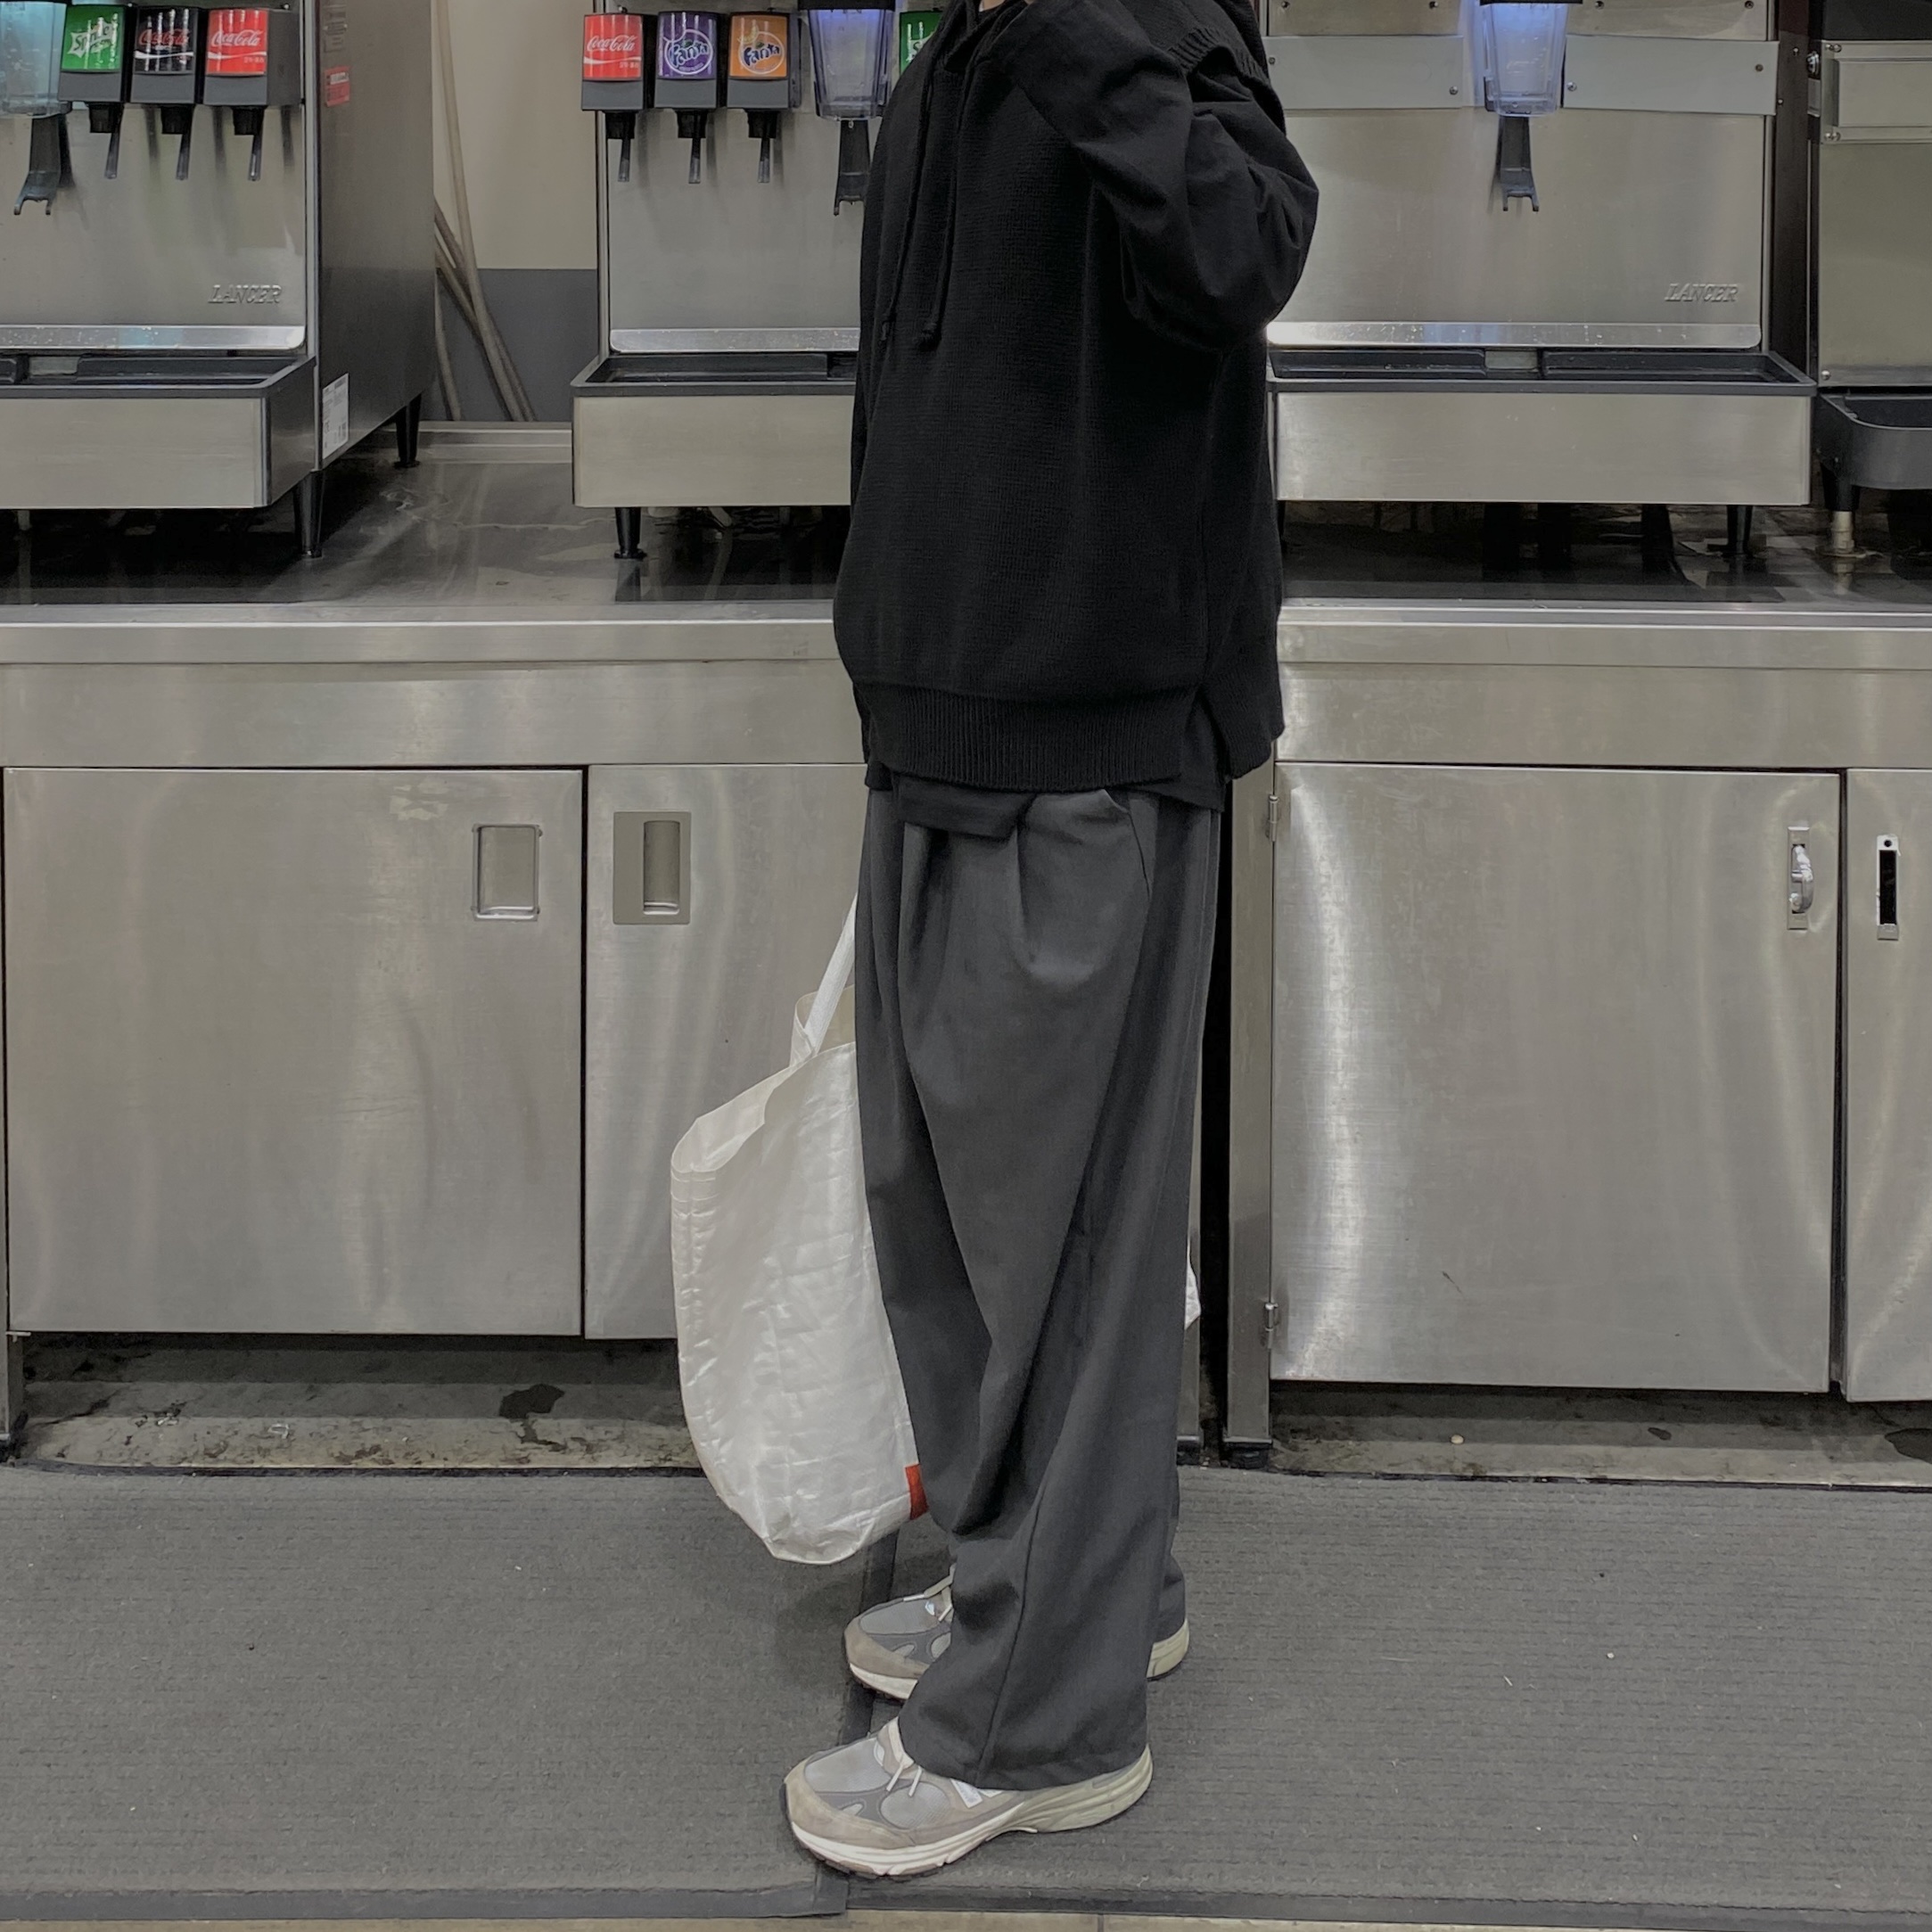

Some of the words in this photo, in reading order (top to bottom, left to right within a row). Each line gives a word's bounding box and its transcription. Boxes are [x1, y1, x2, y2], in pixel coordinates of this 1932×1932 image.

[73, 24, 111, 52] Sprie
[669, 40, 709, 68] Fanta
[743, 43, 780, 67] Fanta
[208, 284, 282, 304] LANCER
[1665, 283, 1738, 302] LANCER
